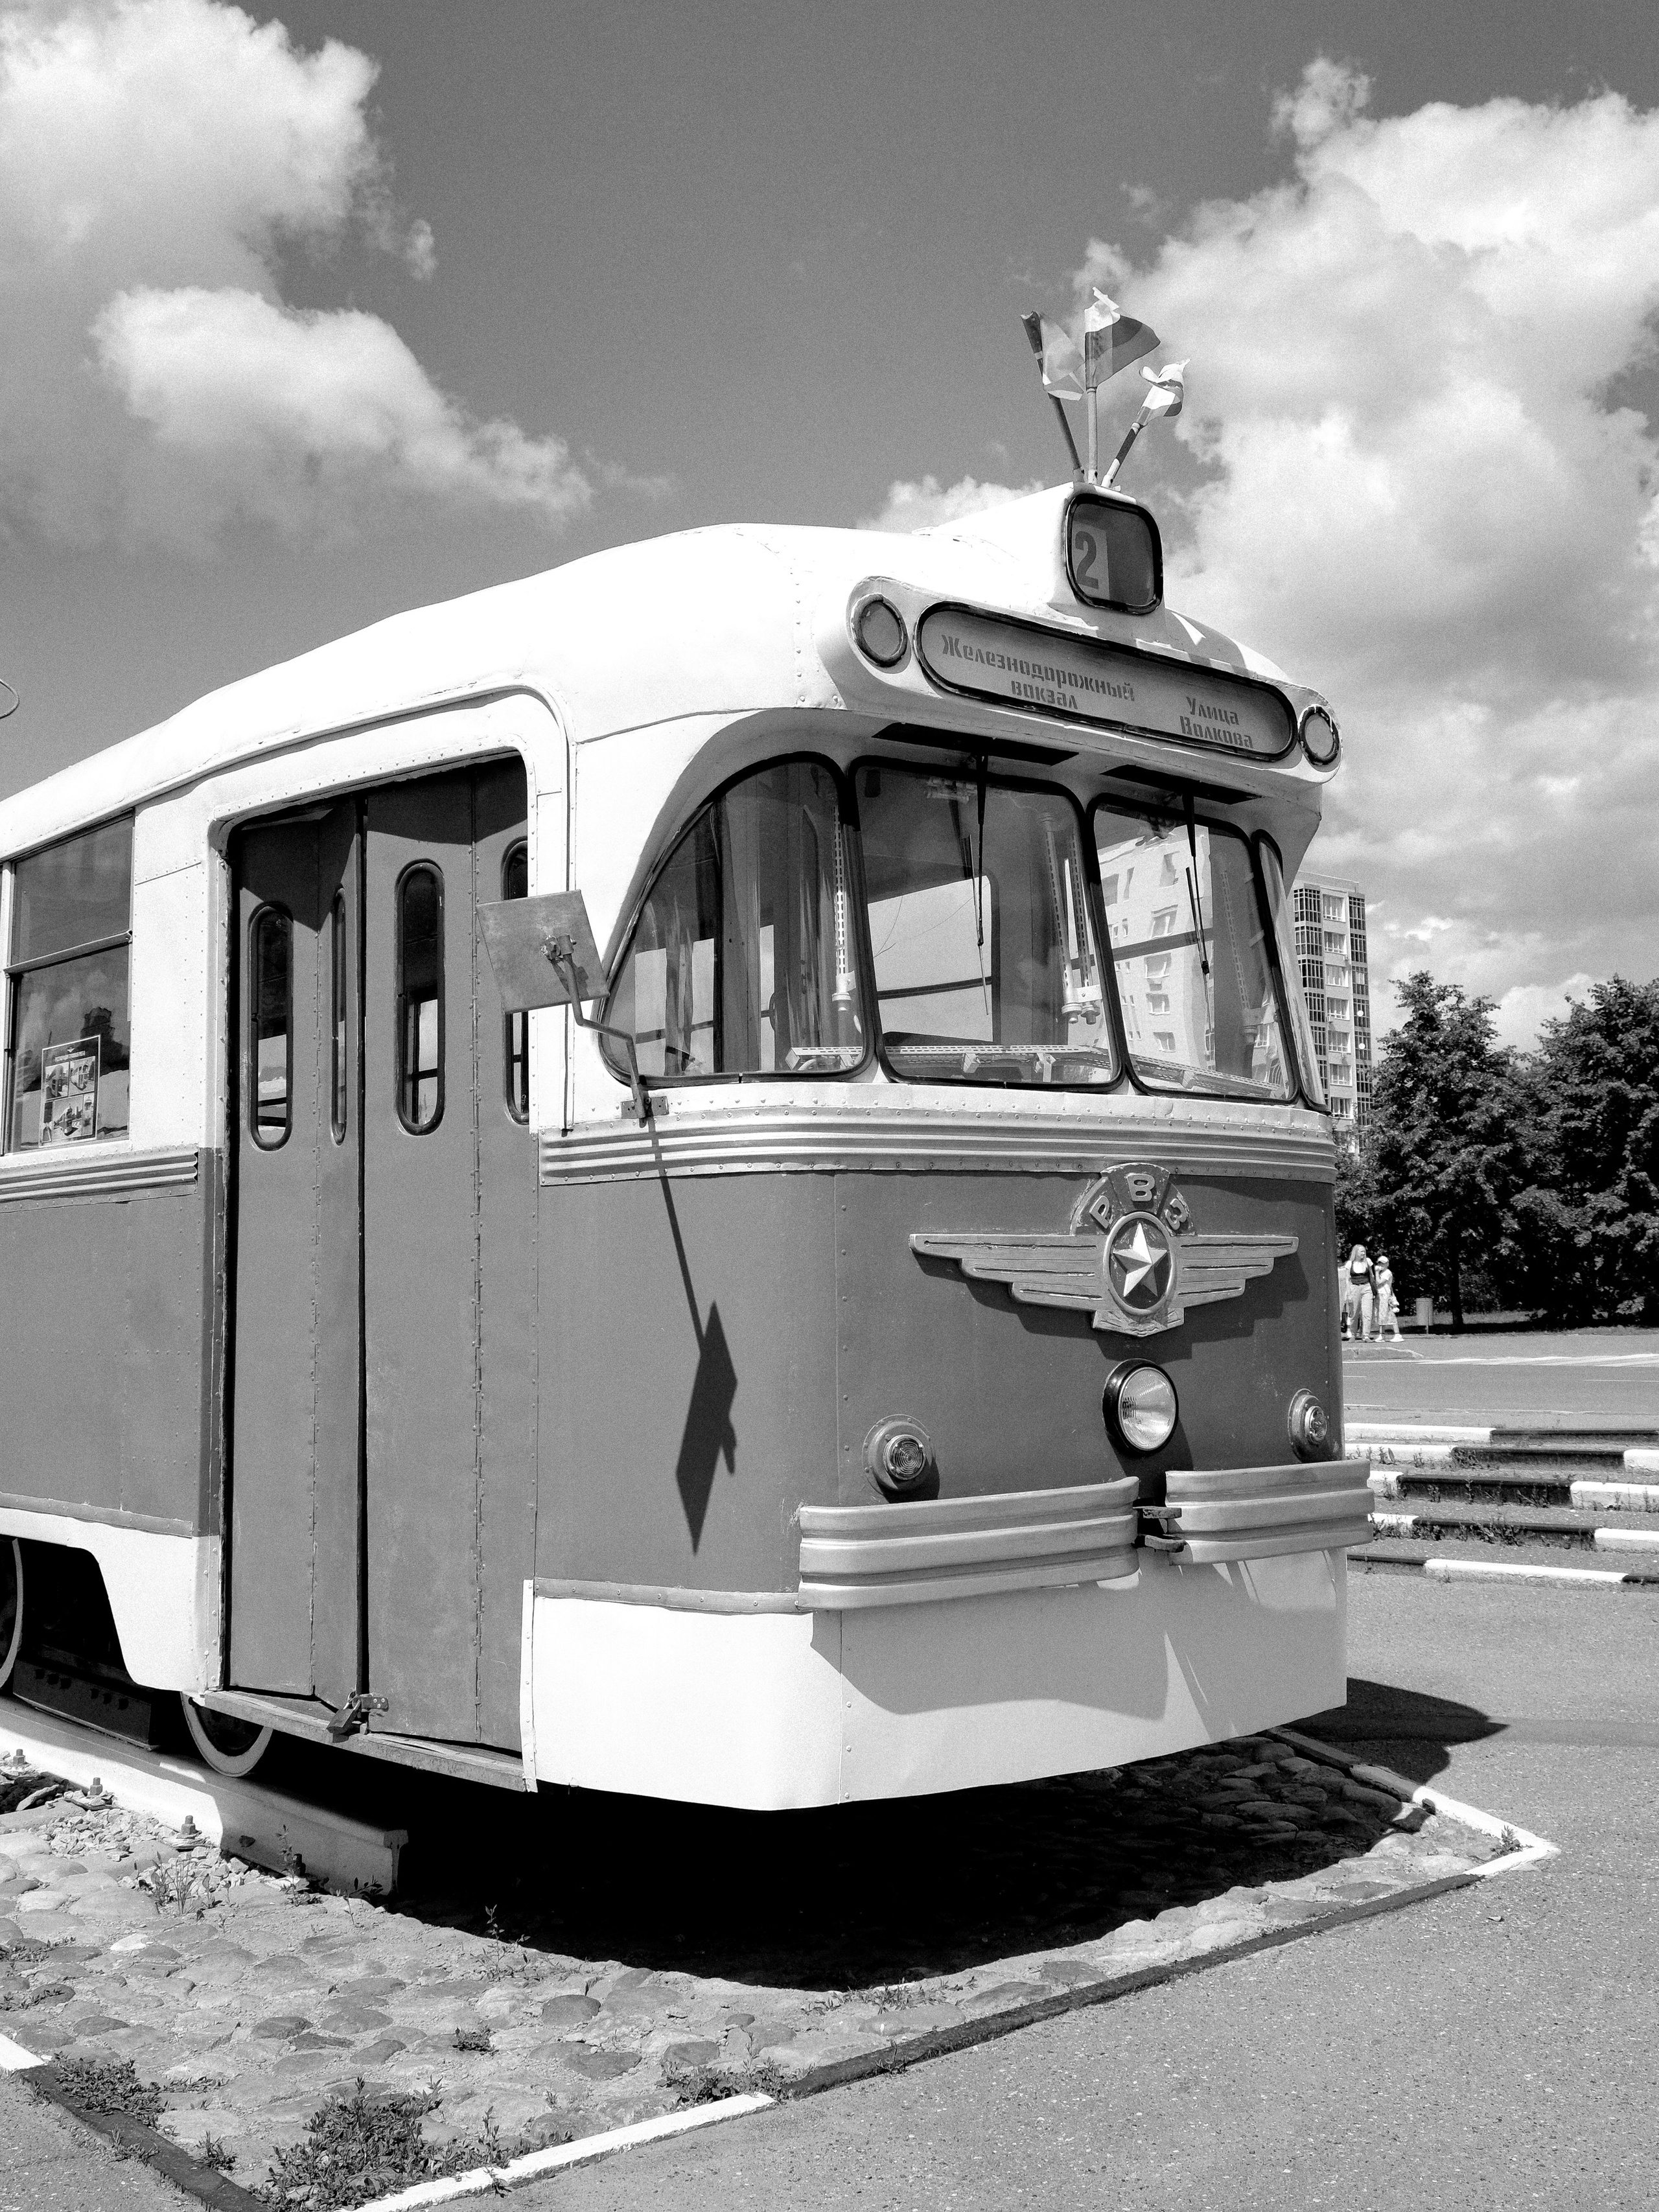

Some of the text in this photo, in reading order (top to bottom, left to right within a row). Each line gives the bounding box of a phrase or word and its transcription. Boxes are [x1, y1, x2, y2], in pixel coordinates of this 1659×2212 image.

[1075, 531, 1098, 589] 2
[941, 634, 1135, 701] Железнодорожный
[1011, 681, 1078, 710] вокзал
[1186, 696, 1239, 726] Улица
[1179, 716, 1253, 749] Волкова
[1089, 1173, 1188, 1231] РВЗ
